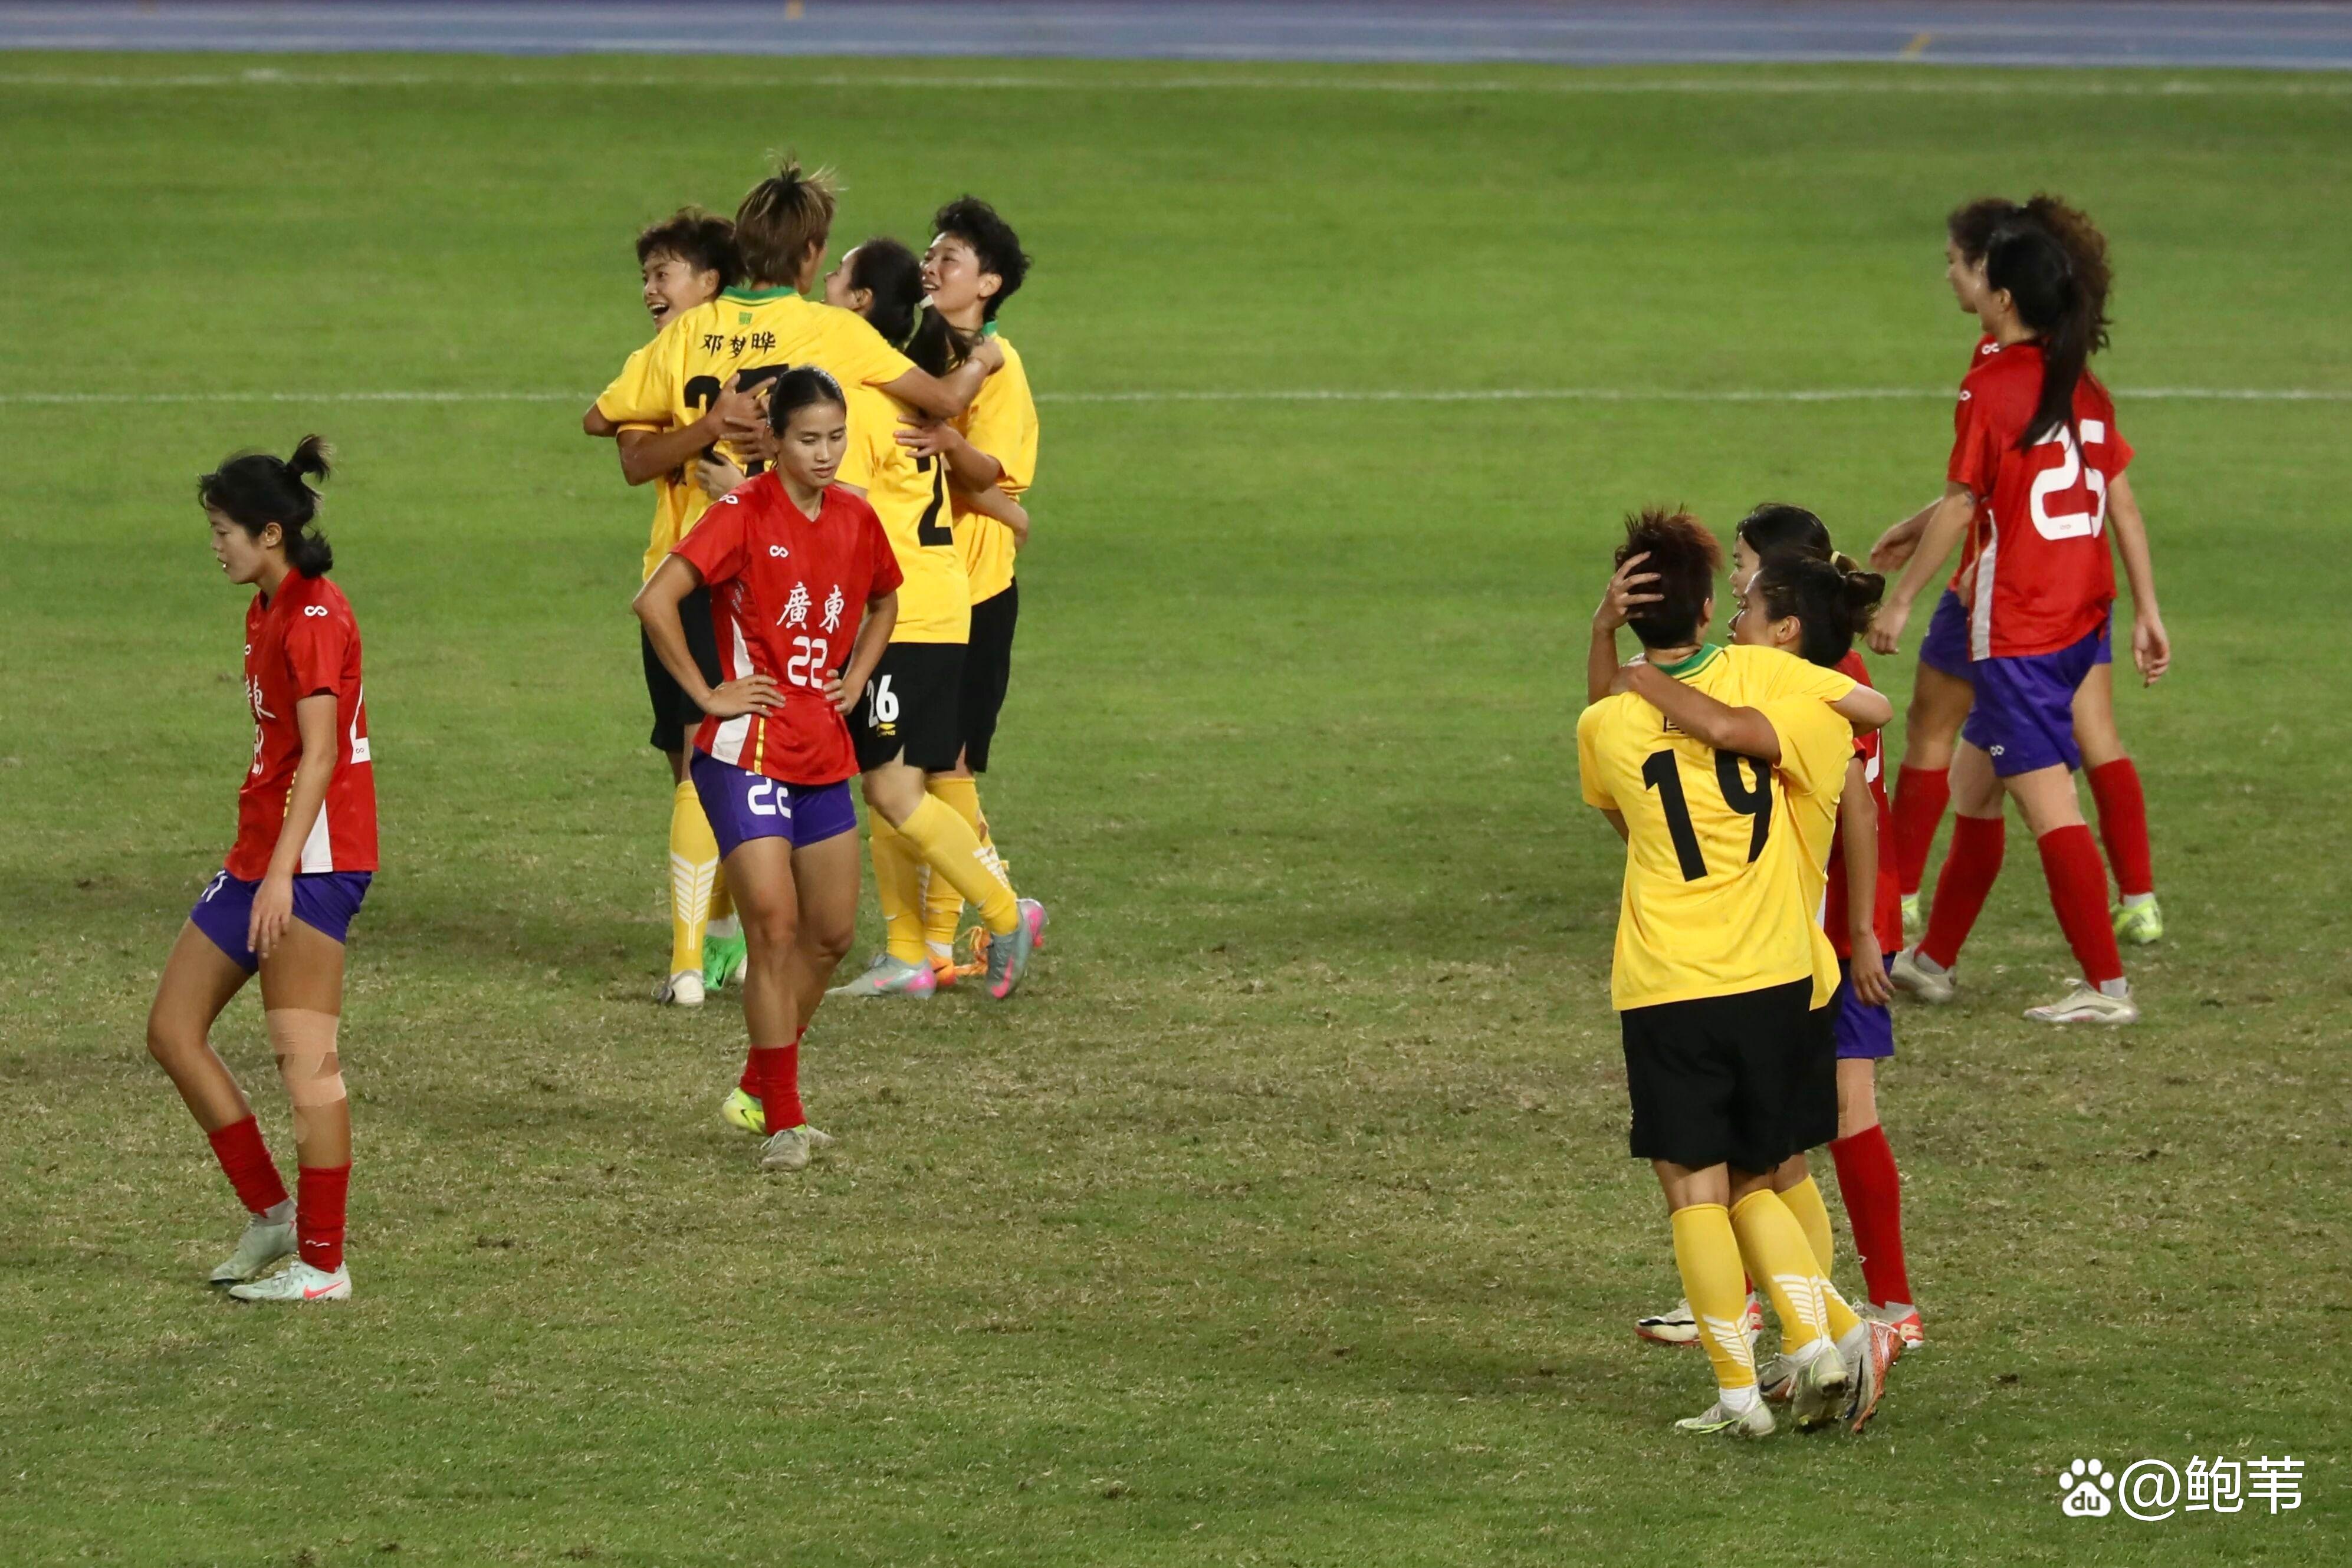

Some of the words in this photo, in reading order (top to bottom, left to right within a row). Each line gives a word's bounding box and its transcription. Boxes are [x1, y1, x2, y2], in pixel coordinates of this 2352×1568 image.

[699, 331, 776, 359] 邓梦晔
[2030, 419, 2107, 541] 25
[776, 581, 845, 634] 廣東
[787, 636, 828, 689] 22
[866, 675, 899, 728] 26
[1641, 748, 1773, 882] 19
